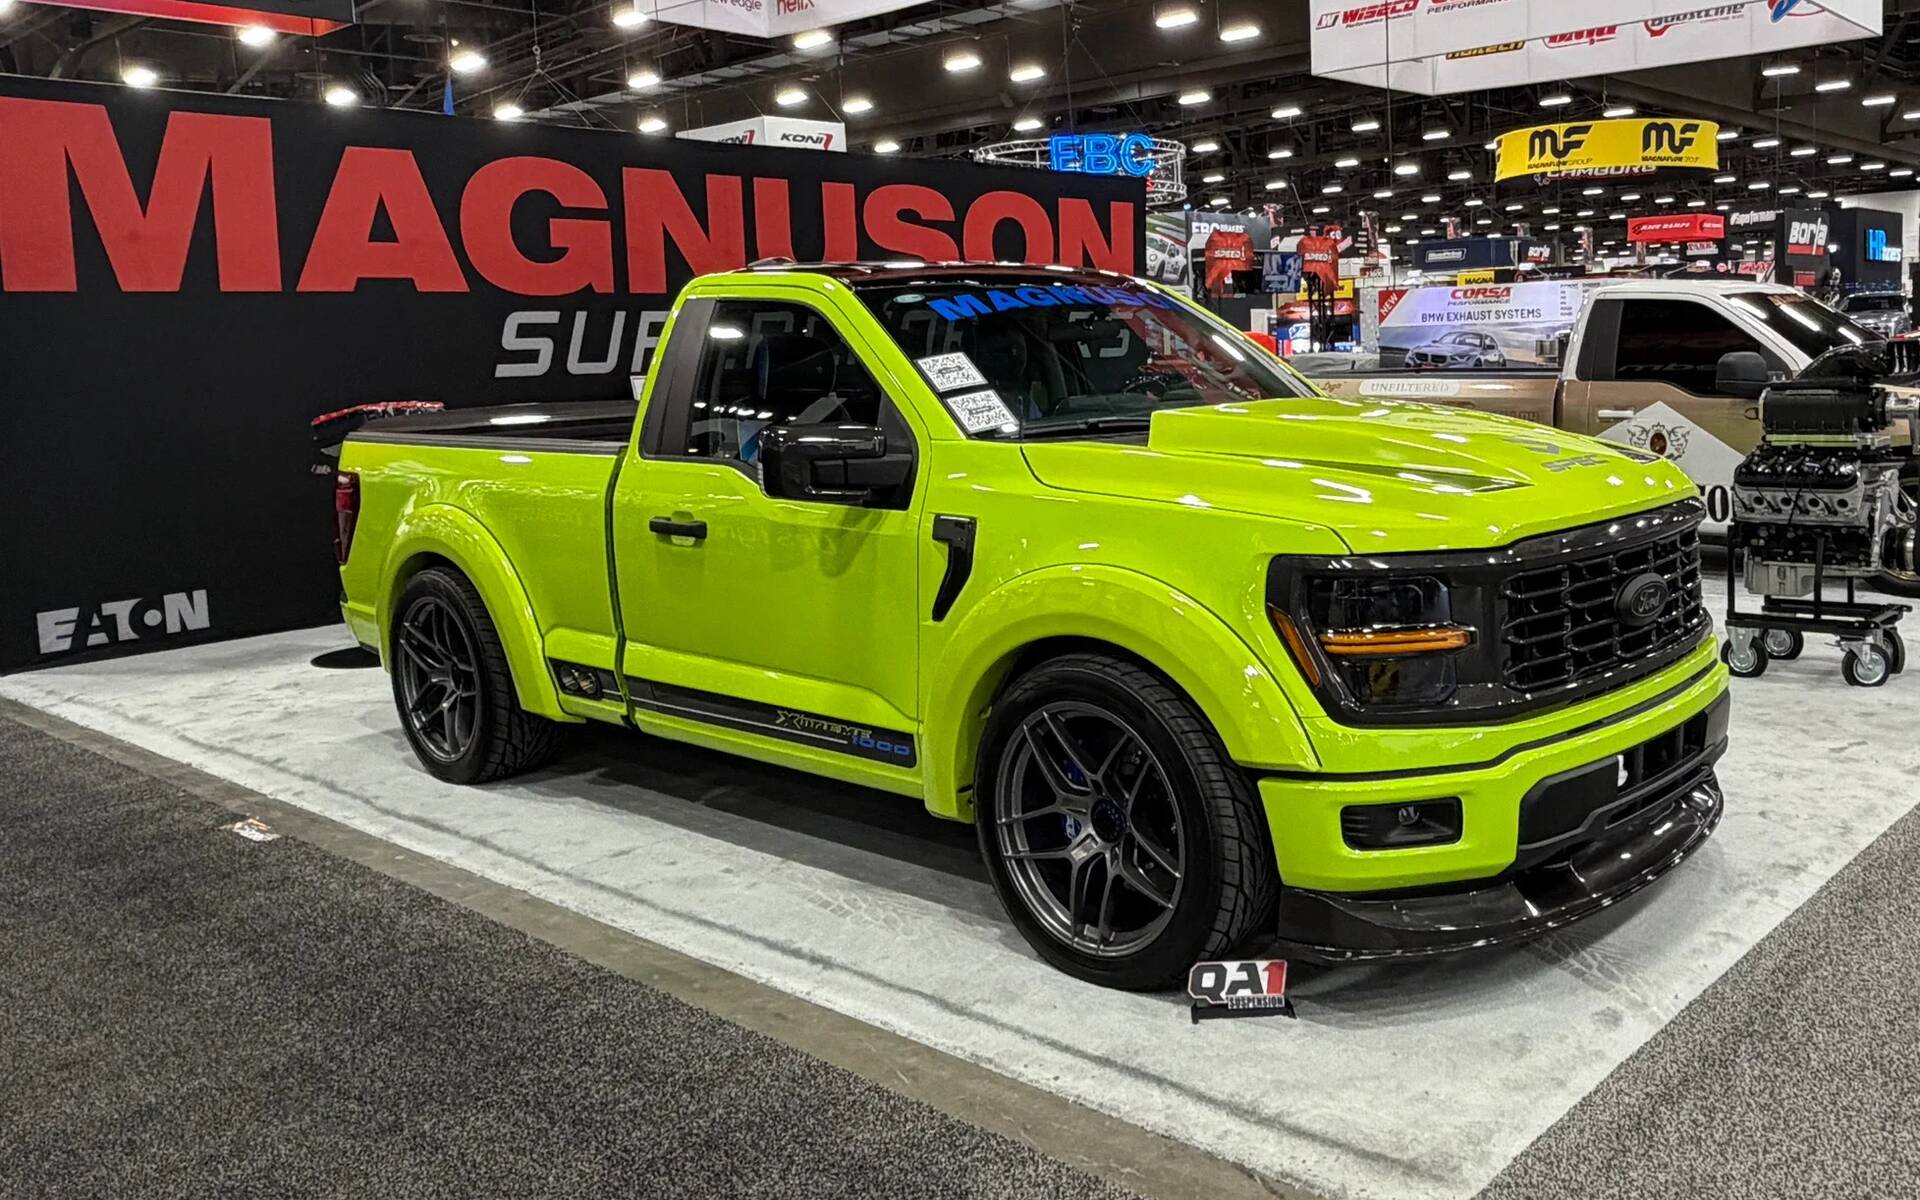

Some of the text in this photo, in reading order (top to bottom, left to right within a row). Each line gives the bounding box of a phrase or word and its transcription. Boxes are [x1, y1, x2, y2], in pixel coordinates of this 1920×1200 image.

[780, 132, 824, 144] KONI
[1051, 134, 1154, 178] EBC
[0, 97, 1135, 298] MAGNUSON
[1450, 287, 1513, 299] CORSA
[1380, 293, 1398, 316] NEW
[1421, 308, 1542, 323] BMW EXHAUST SYSTEMS
[1371, 383, 1449, 393] UNFILTERED
[36, 589, 211, 655] EATON
[1189, 961, 1286, 1004] QA1
[1228, 996, 1285, 1009] SUSPENSION
